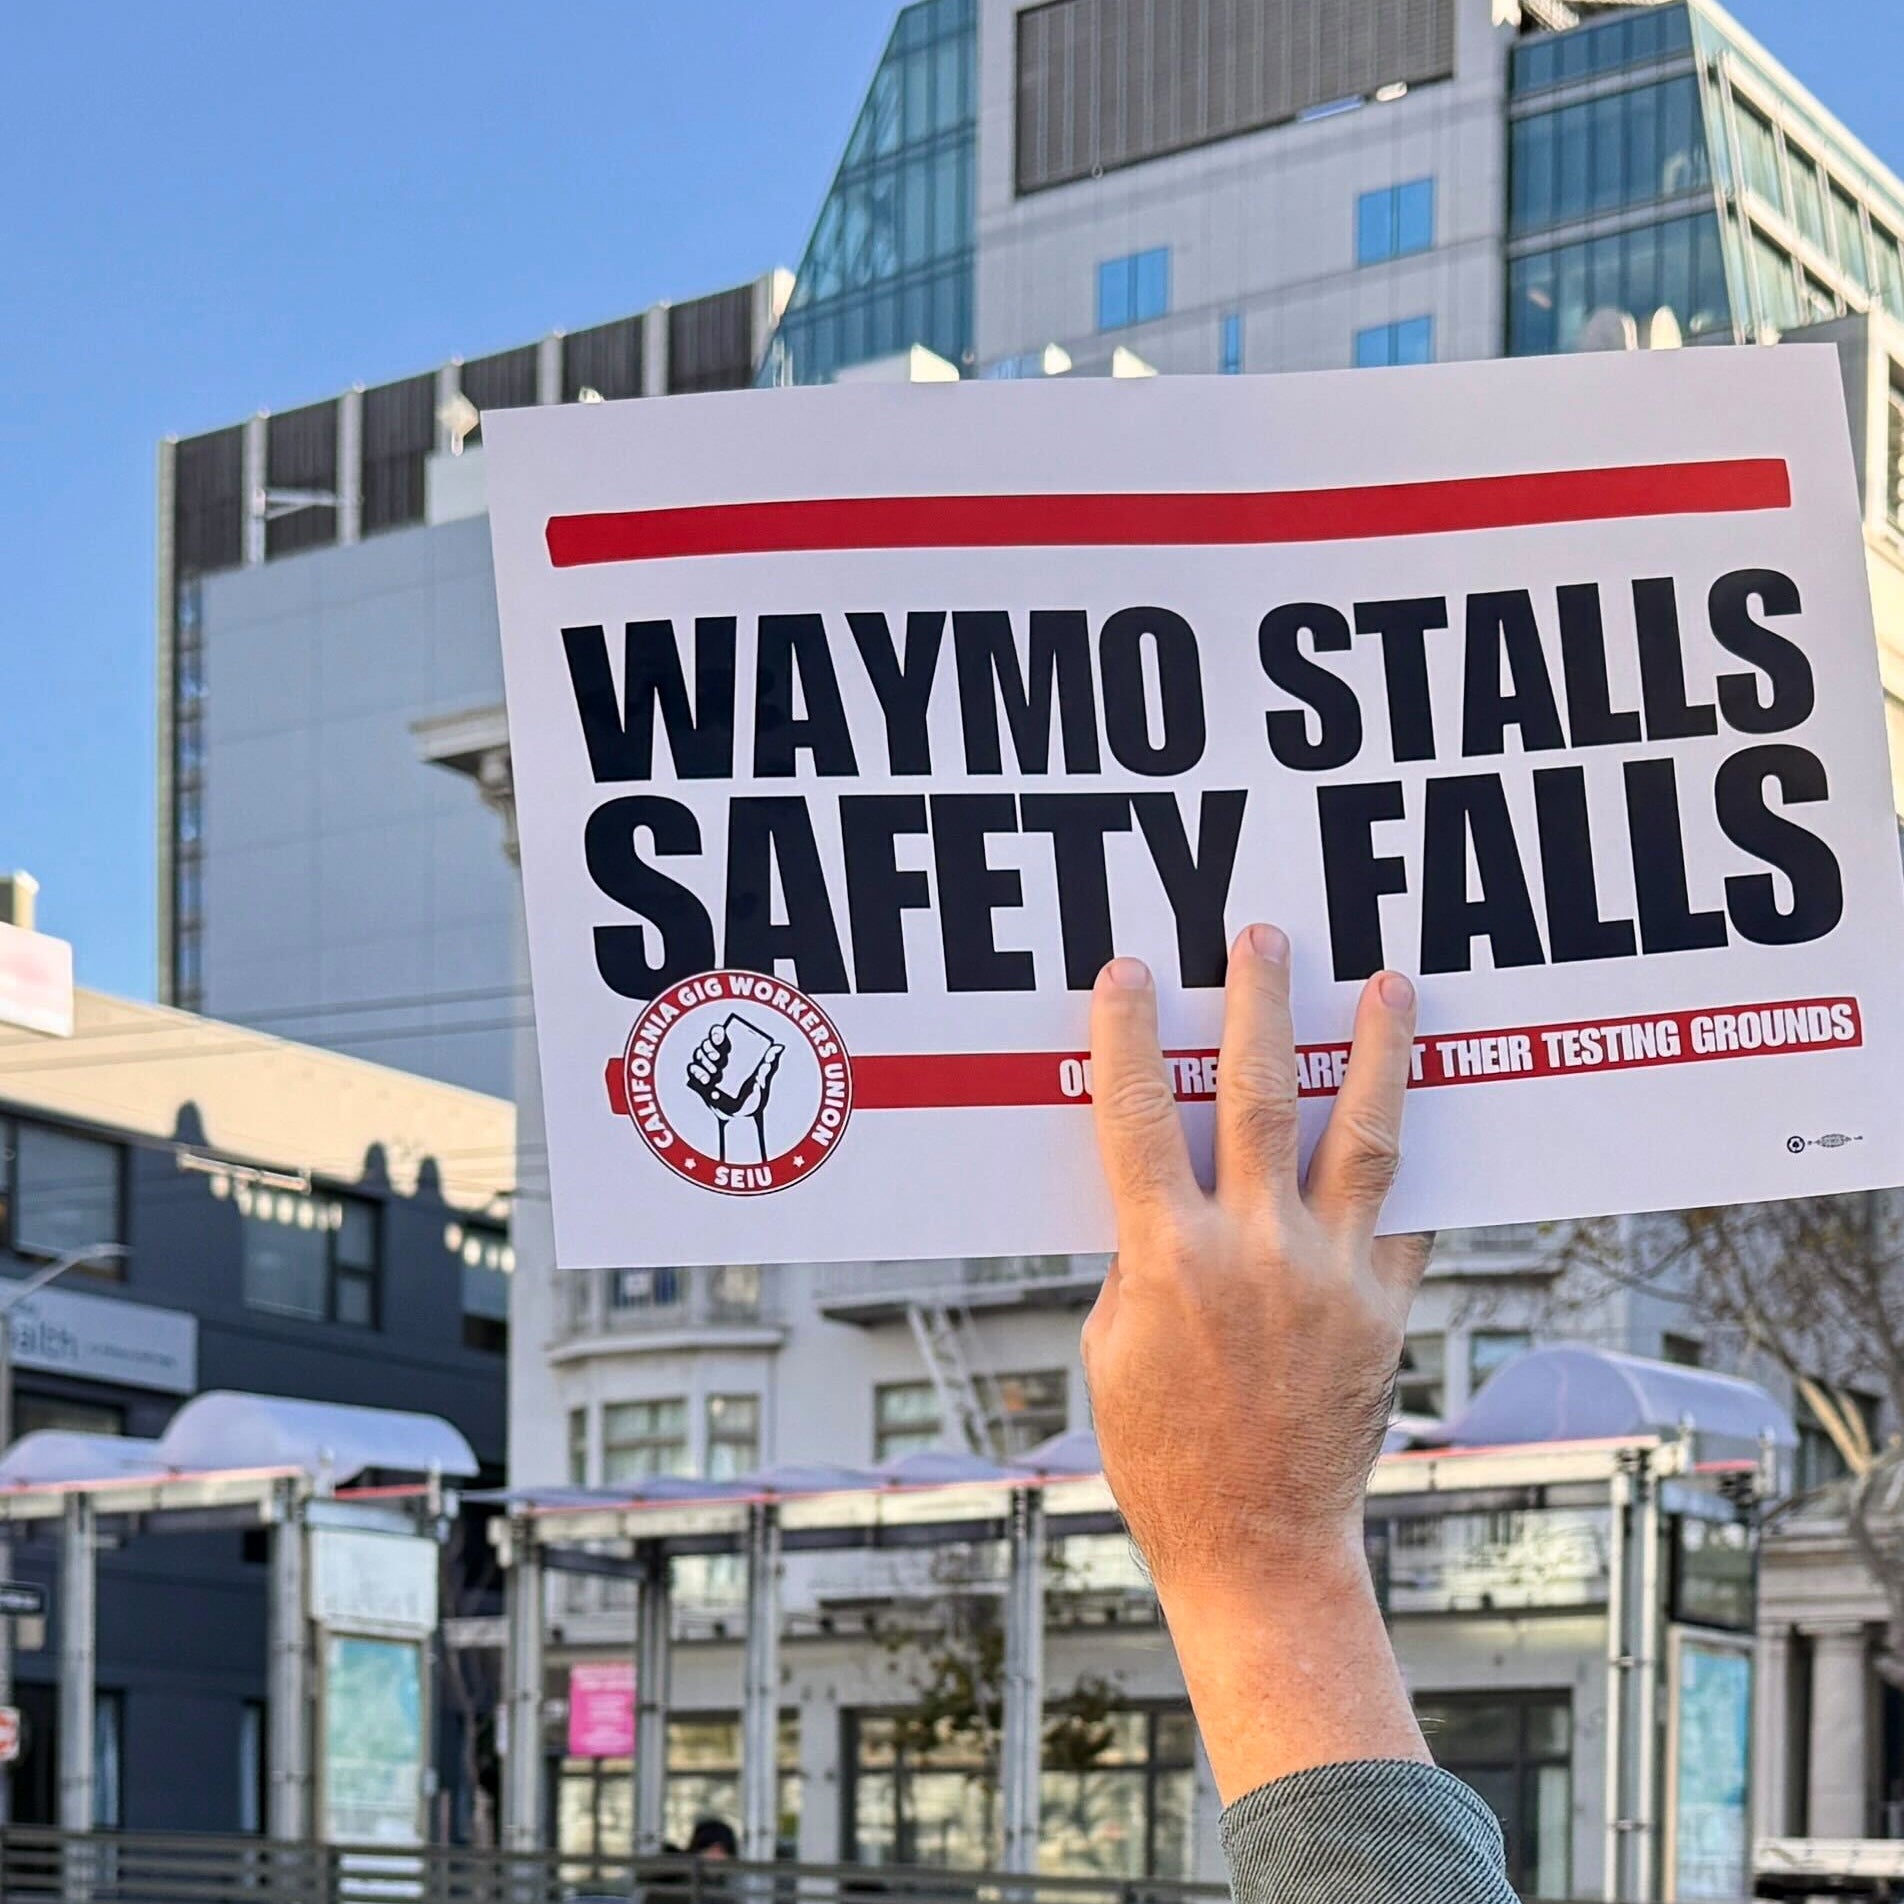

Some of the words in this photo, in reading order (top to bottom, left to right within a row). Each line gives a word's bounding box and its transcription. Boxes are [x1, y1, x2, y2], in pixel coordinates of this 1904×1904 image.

[560, 605, 1207, 784] WAYMO
[1257, 567, 1816, 772] STALLS
[583, 788, 1249, 1002] SAFETY
[1315, 743, 1844, 983] FALLS
[630, 1003, 680, 1149] CALIFORNIA
[677, 977, 724, 1008] GIG
[728, 975, 838, 1058] WORKERS
[811, 1063, 846, 1147] UNION
[1436, 1034, 1534, 1078] THEIR
[1541, 1020, 1682, 1069] TESTING
[1690, 1003, 1857, 1054] GROUNDS
[714, 1165, 773, 1189] SEIU
